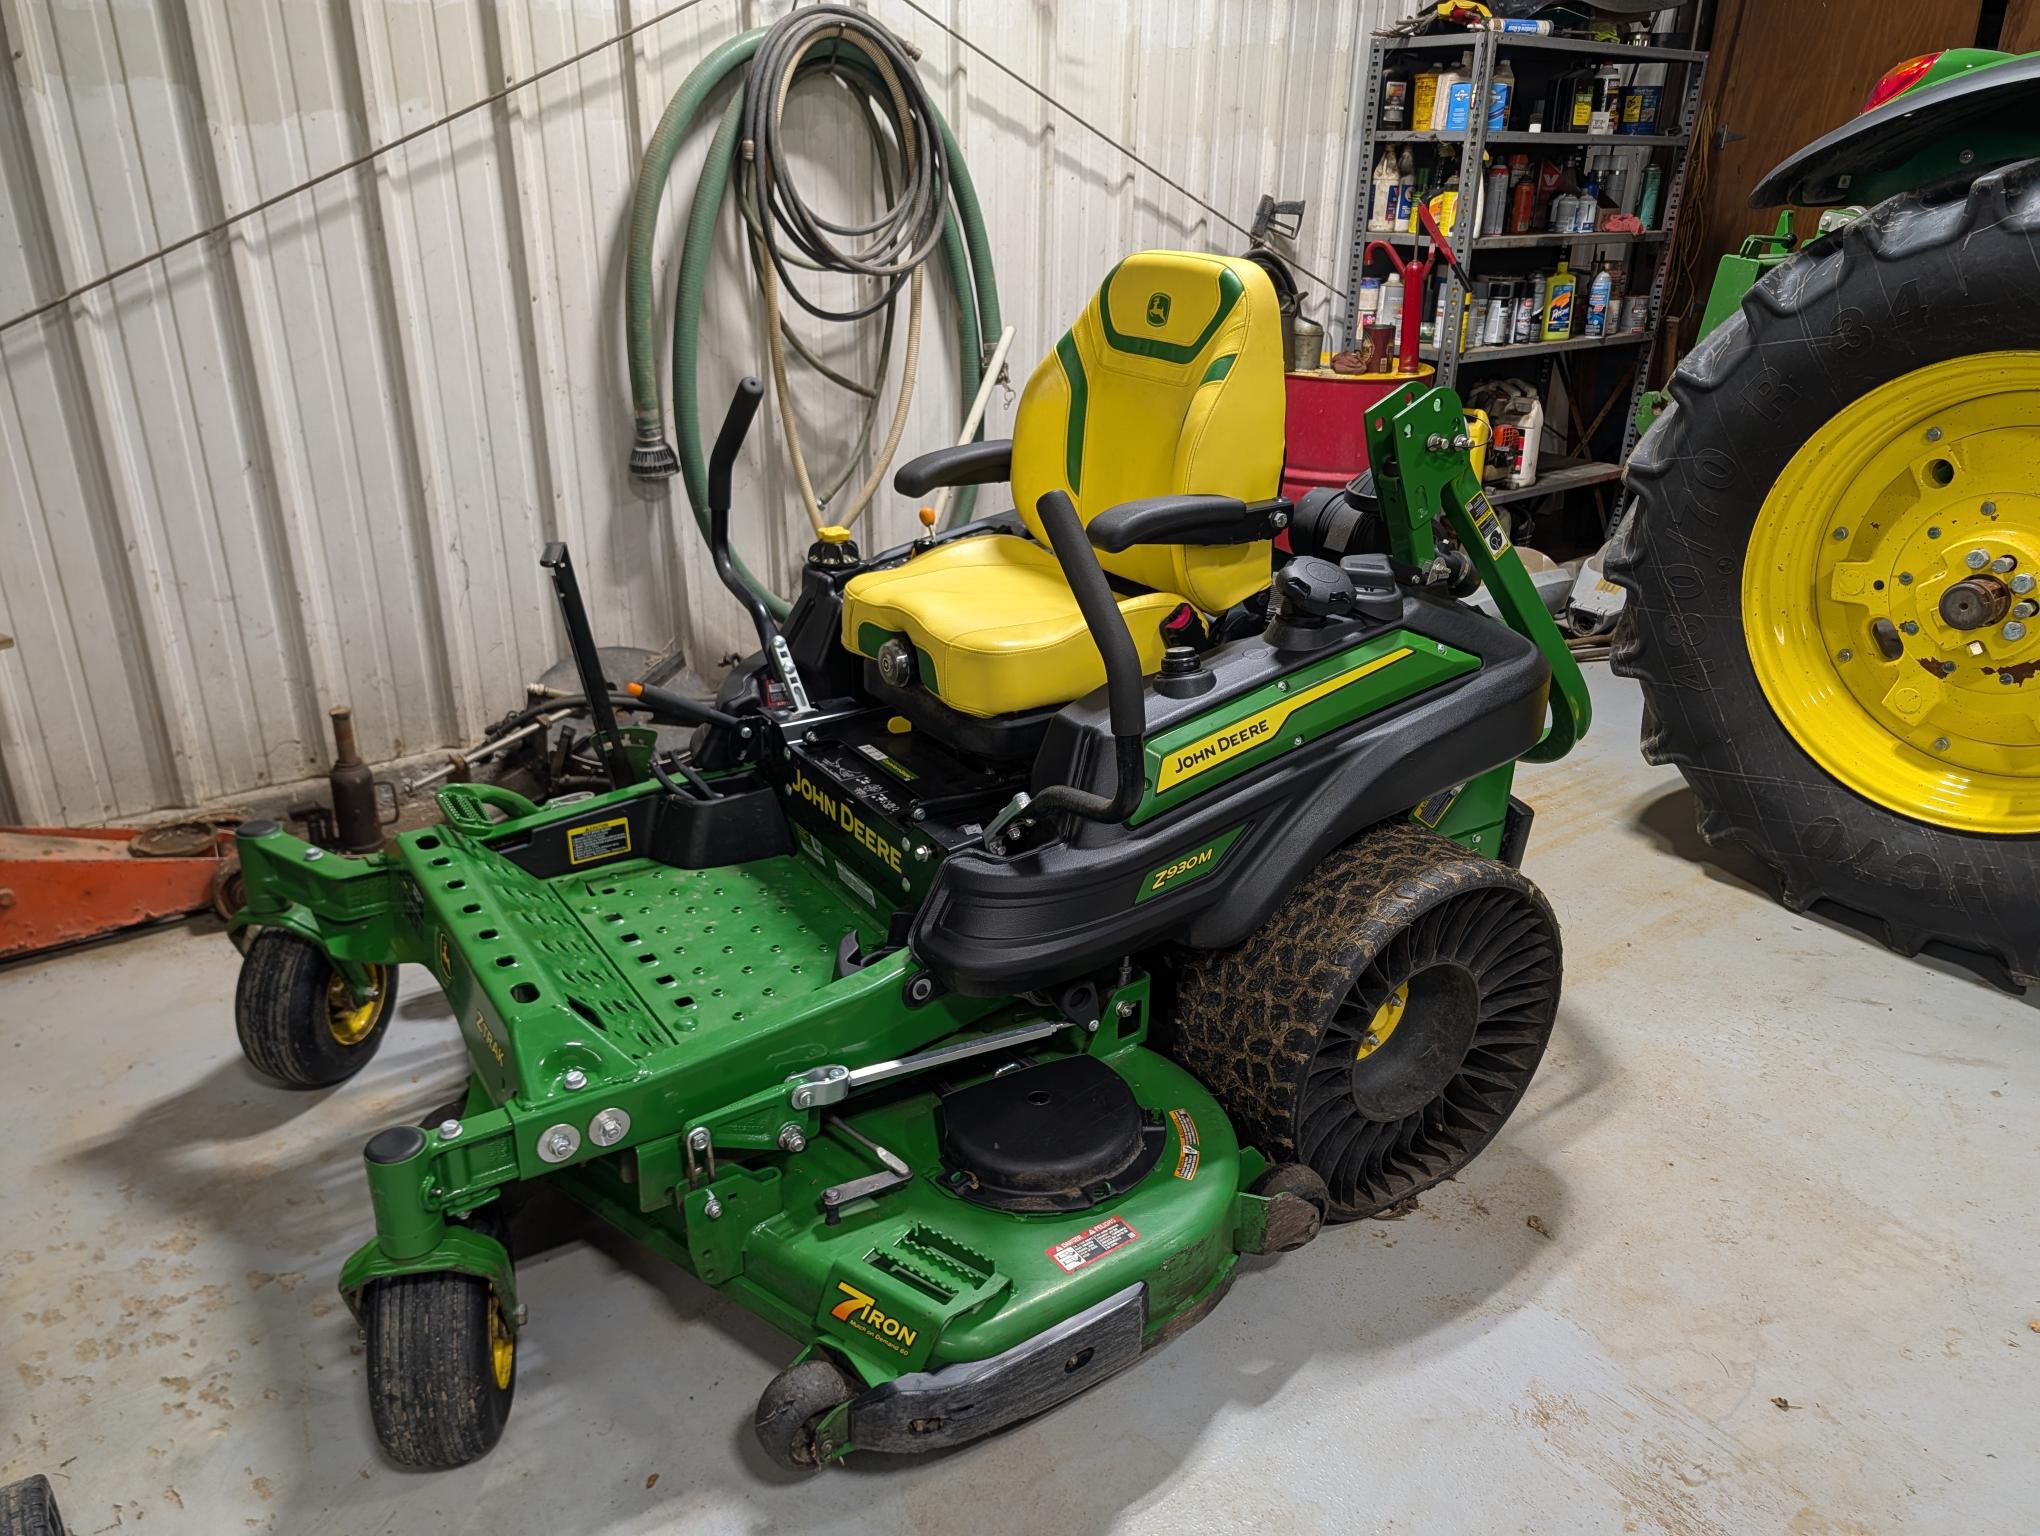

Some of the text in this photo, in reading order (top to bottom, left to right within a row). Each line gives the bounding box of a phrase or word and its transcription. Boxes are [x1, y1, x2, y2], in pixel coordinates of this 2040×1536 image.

[1174, 718, 1270, 775] JOHN DEERE
[791, 768, 837, 823] JOHN
[839, 801, 904, 875] DEERE
[1151, 848, 1214, 891] Z930M
[474, 1008, 505, 1068] ZTRAK
